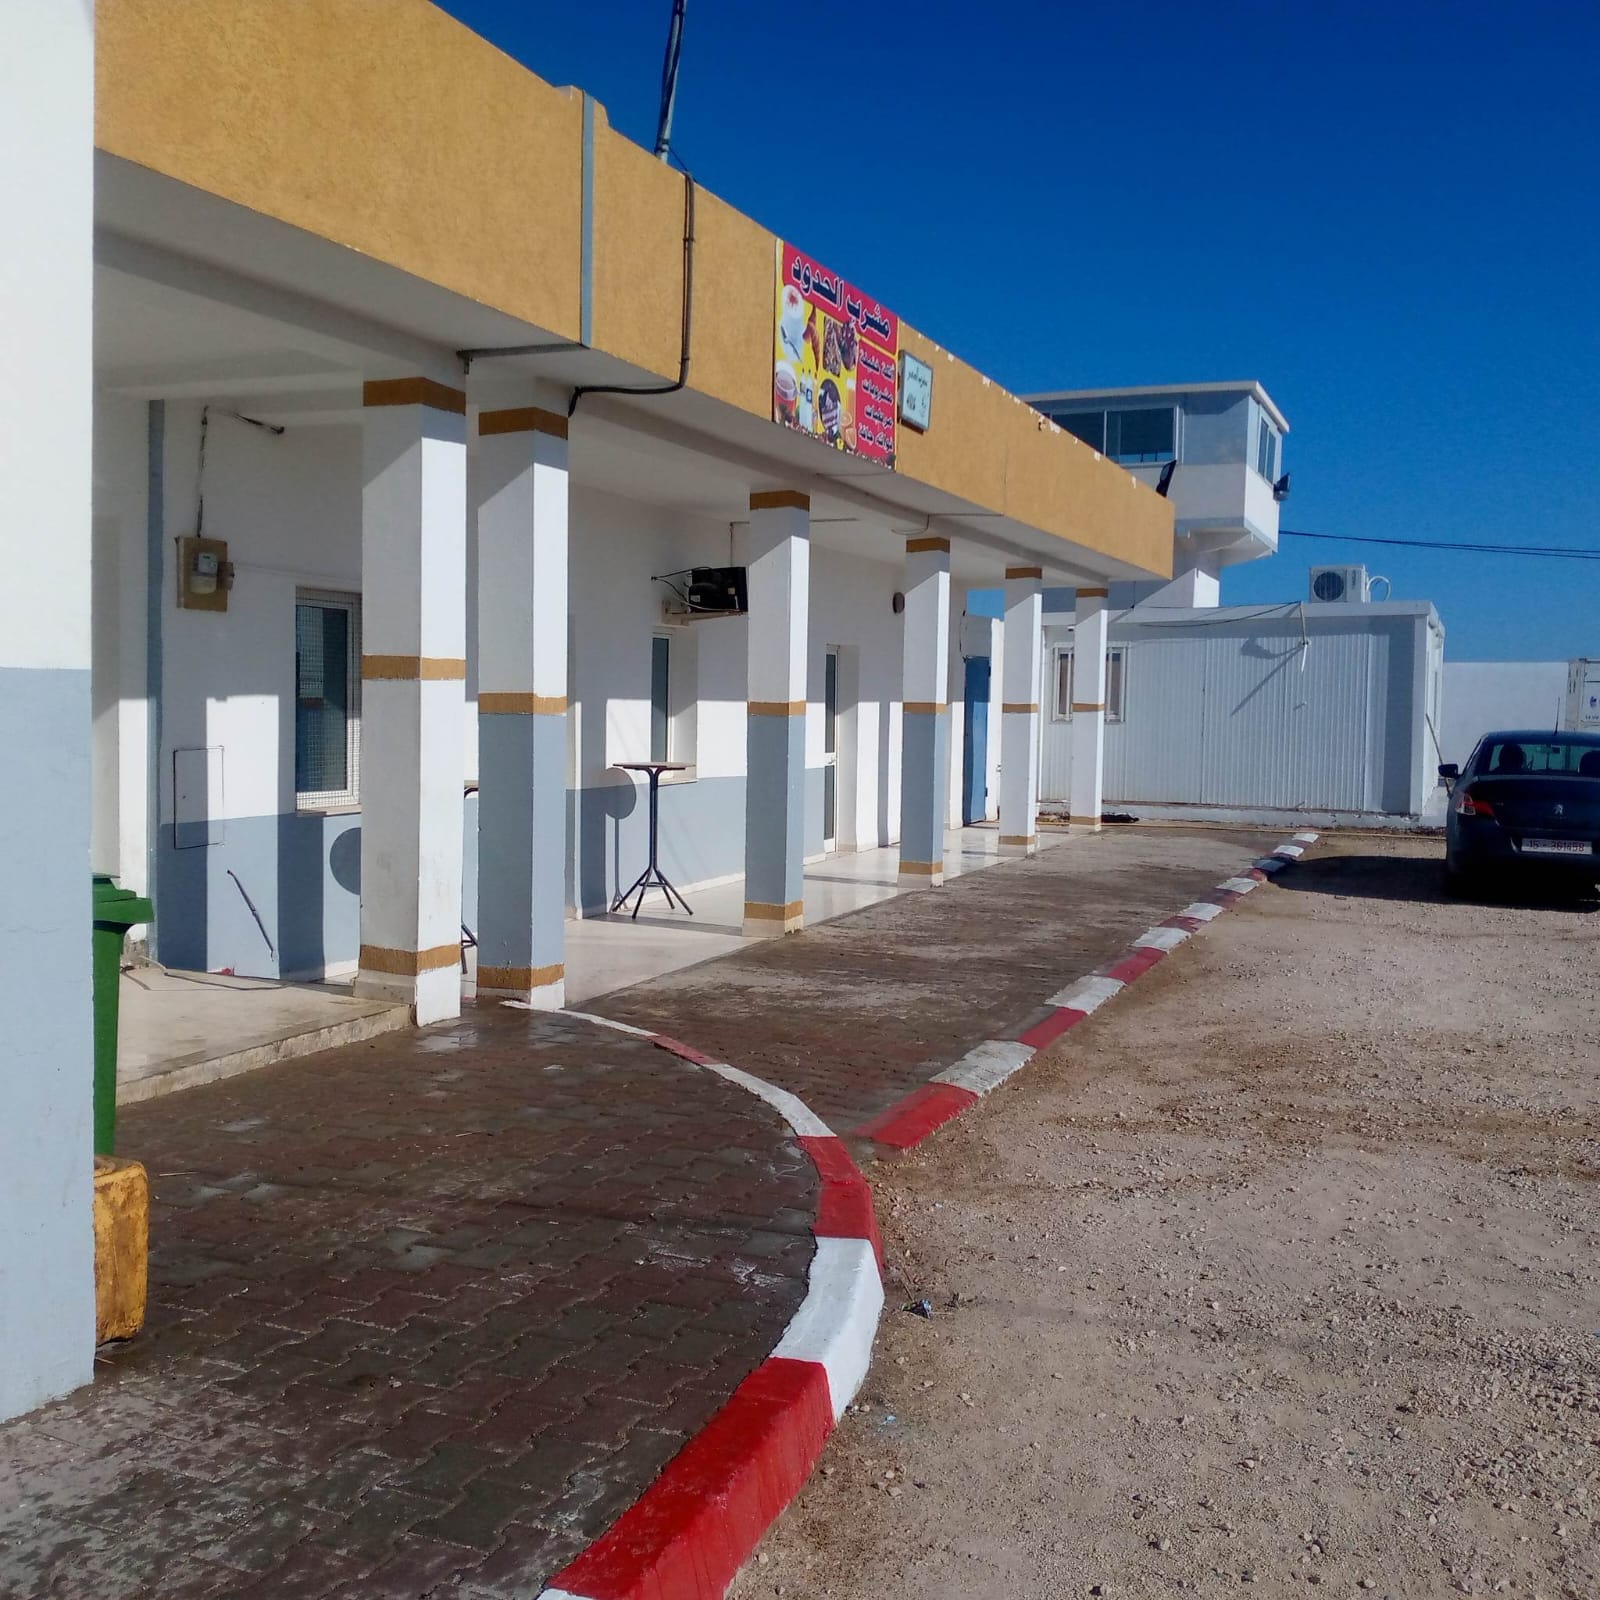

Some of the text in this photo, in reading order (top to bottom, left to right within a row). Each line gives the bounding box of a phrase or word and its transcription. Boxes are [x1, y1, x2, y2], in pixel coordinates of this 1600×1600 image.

[791, 256, 891, 341] مشرب الحدود
[861, 378, 893, 405] مشروبات
